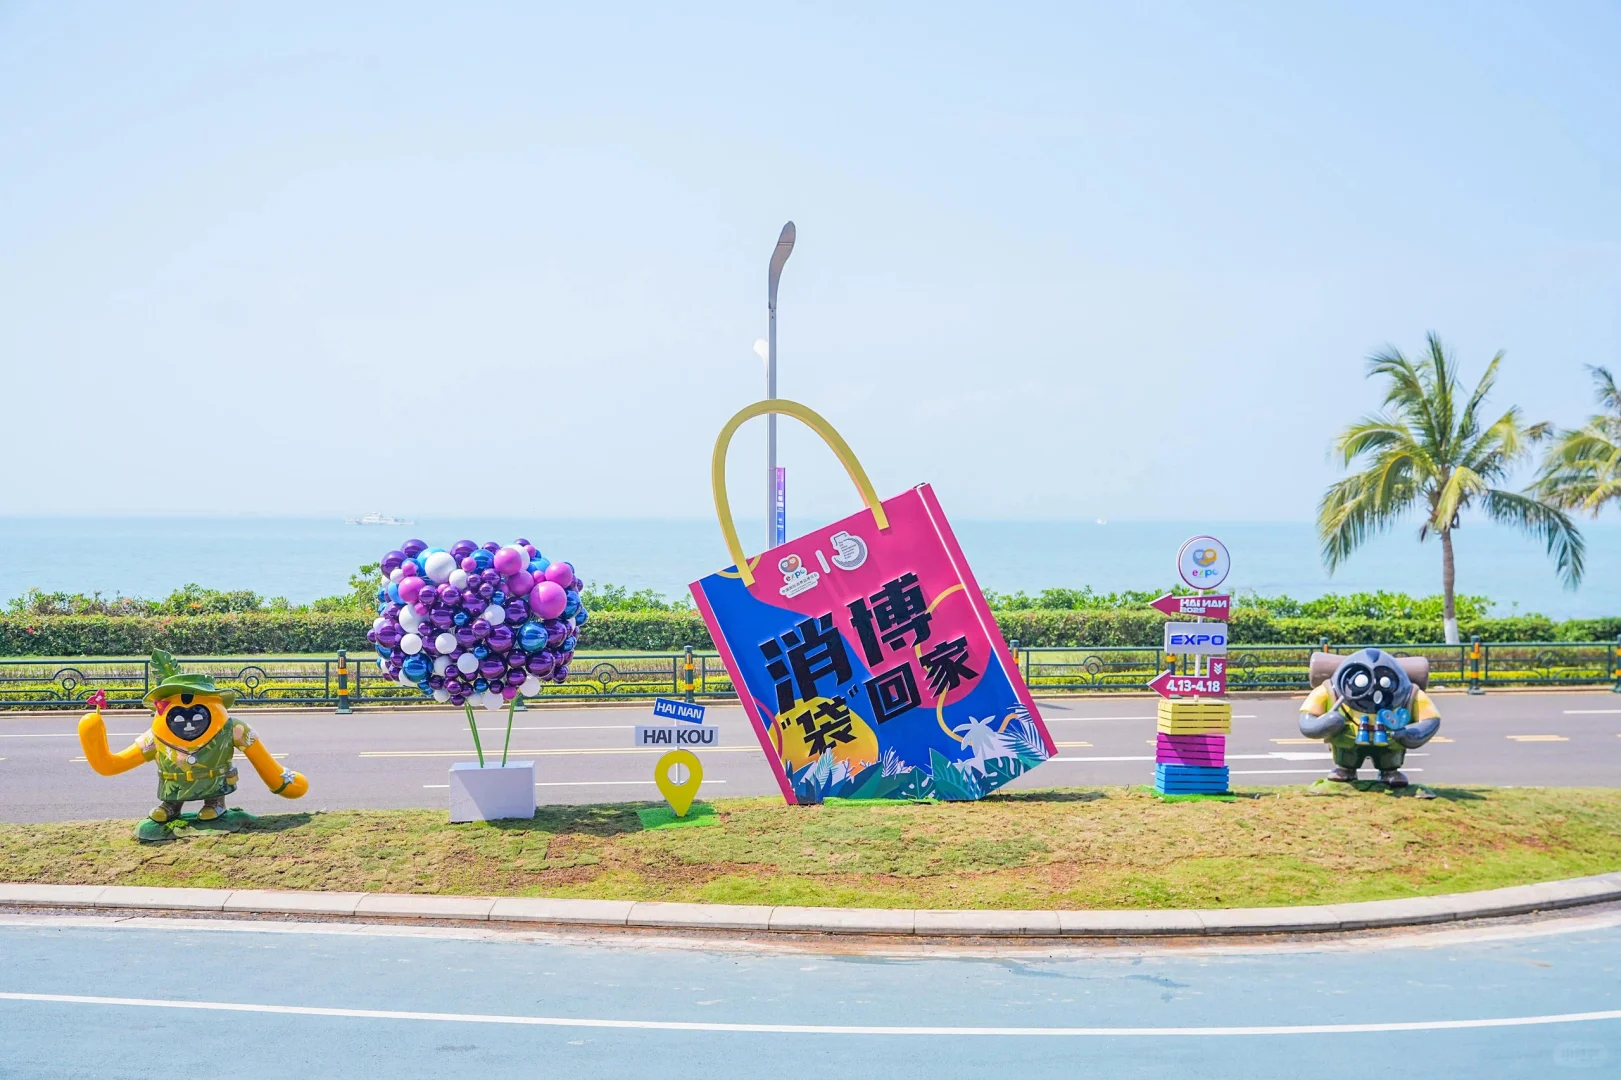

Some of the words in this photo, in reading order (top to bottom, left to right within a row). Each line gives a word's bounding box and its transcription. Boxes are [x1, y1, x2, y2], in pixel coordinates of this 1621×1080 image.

[1180, 598, 1201, 607] HAI
[759, 571, 933, 716] 消博
[1170, 635, 1225, 645] EXPO
[1166, 679, 1221, 692] 4.13-4.18
[656, 702, 676, 714] HAI
[677, 706, 702, 719] NAN
[643, 729, 672, 744] HAI
[676, 729, 714, 744] KOU
